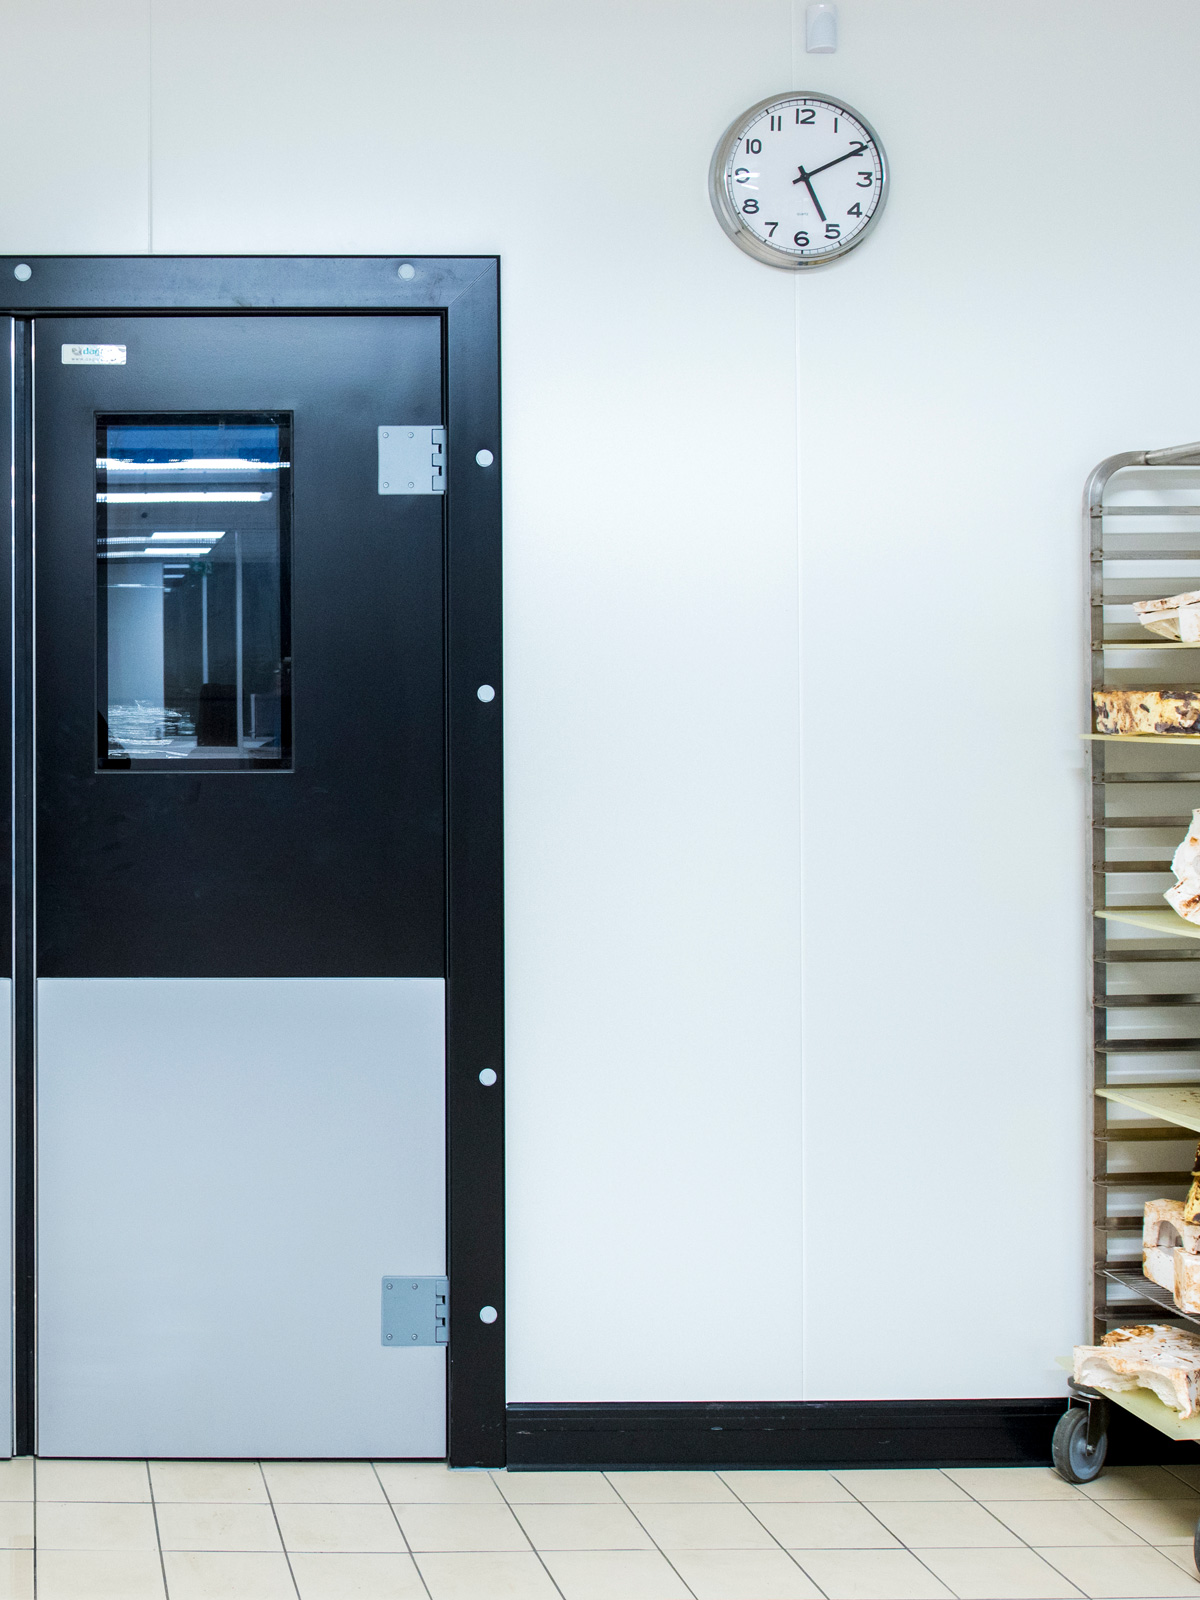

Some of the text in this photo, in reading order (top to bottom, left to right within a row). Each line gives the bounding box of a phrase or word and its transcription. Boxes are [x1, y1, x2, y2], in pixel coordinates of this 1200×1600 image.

[771, 116, 782, 131] 11
[796, 108, 816, 124] 12
[834, 118, 838, 133] 1
[746, 139, 762, 154] 10
[849, 141, 864, 157] 2
[856, 172, 873, 188] 3
[742, 199, 760, 214] 8
[847, 202, 862, 218] 4
[764, 222, 778, 237] 7
[824, 224, 841, 239] 5
[794, 231, 810, 246] 6
